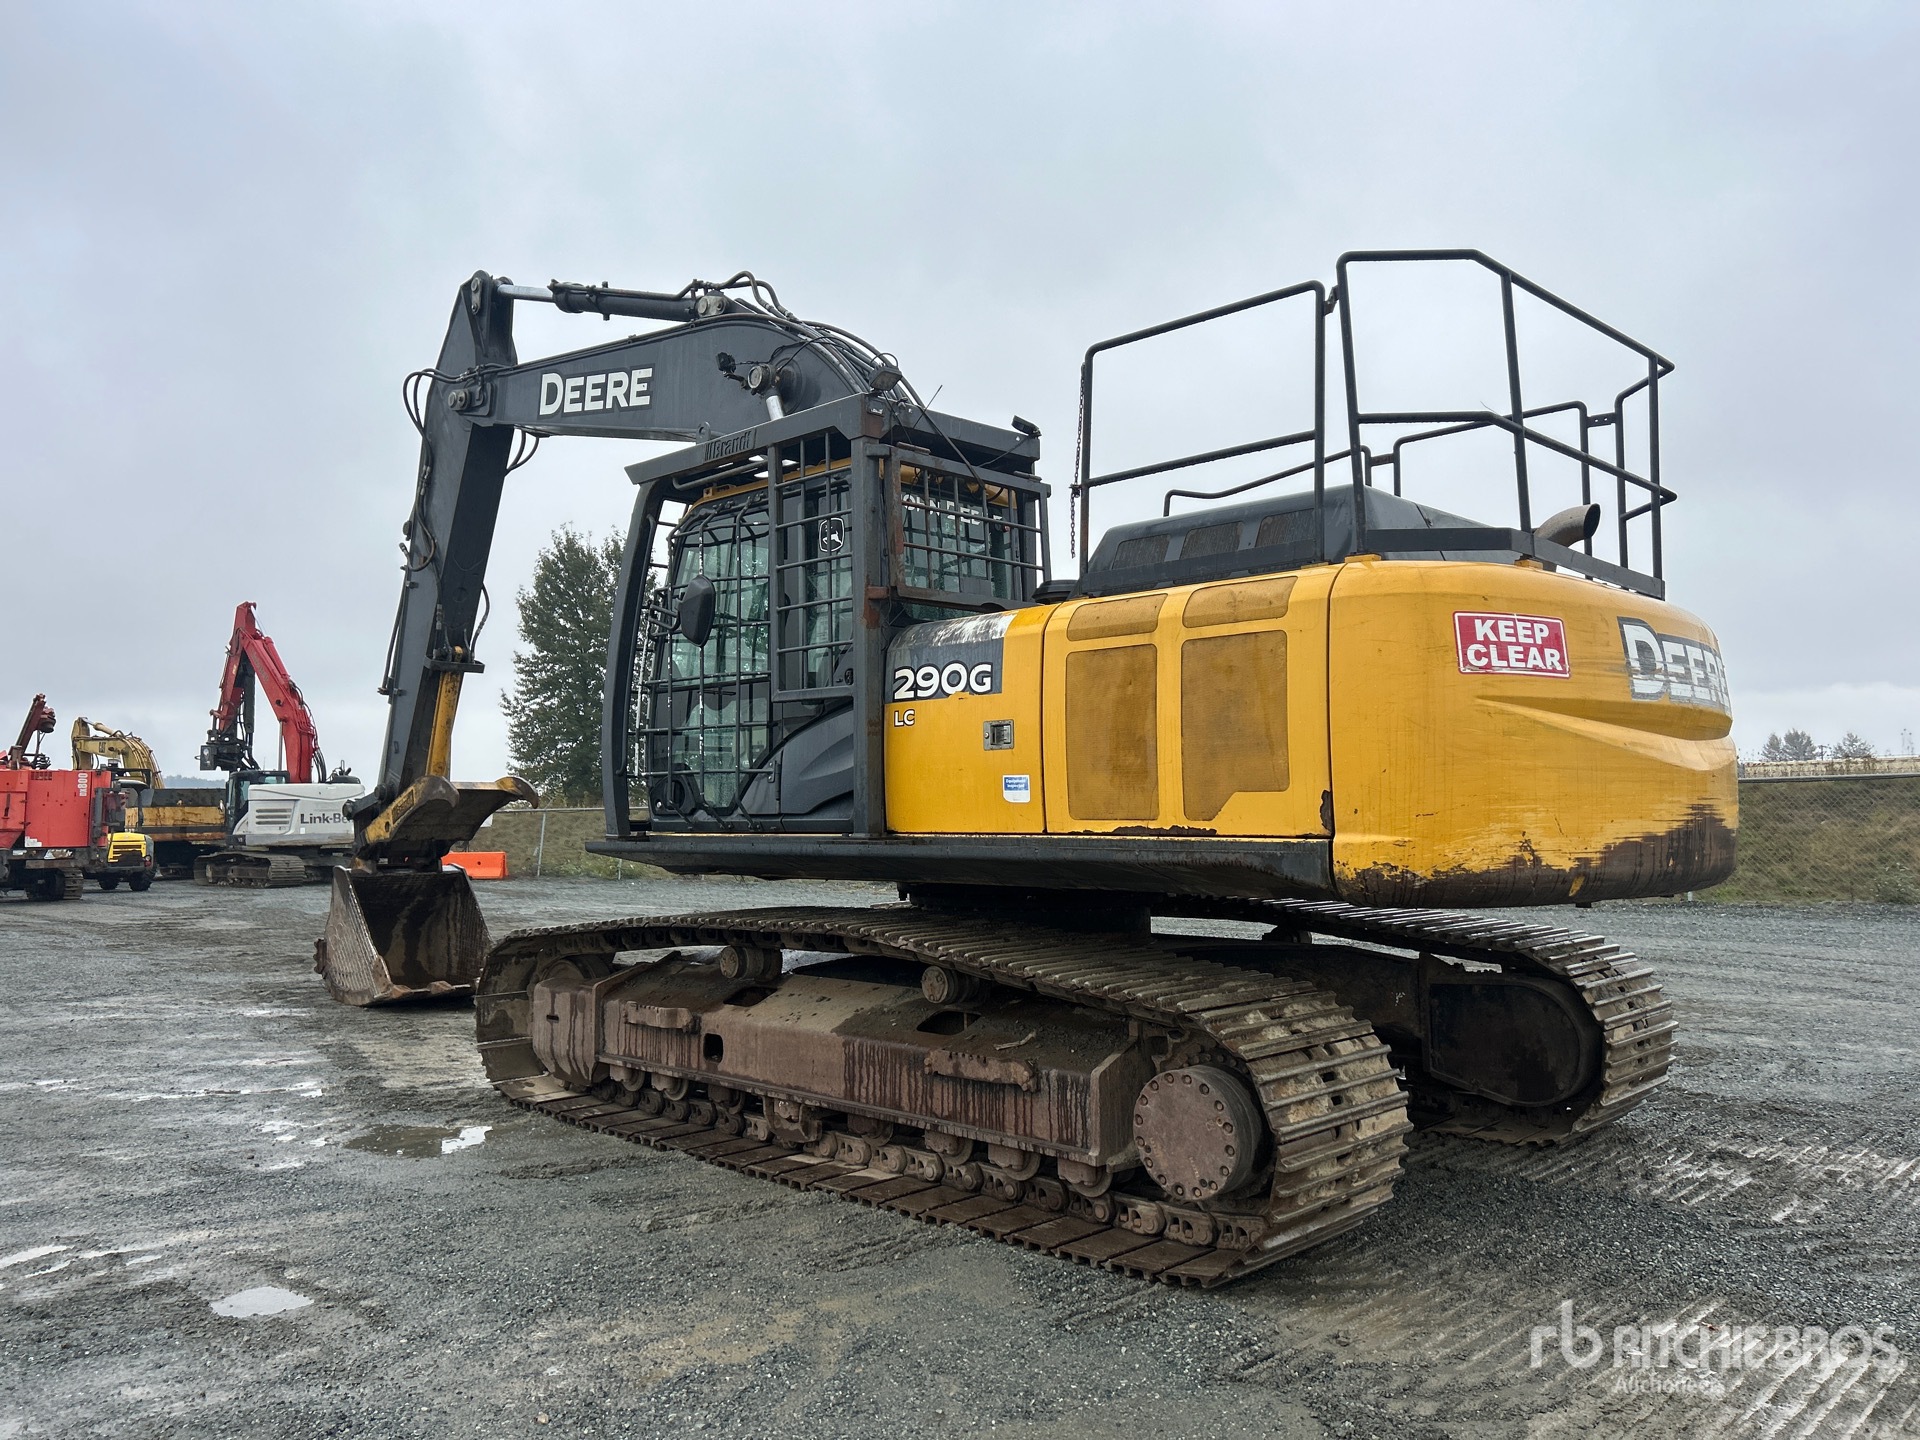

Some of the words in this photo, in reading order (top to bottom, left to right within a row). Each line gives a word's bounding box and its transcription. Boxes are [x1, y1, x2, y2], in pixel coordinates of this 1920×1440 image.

[539, 367, 652, 415] DEERE
[1474, 618, 1549, 644] KEEP
[1466, 643, 1563, 671] CLEAR
[894, 662, 992, 699] 290G
[894, 709, 915, 726] LC
[300, 812, 350, 824] Link-Be
